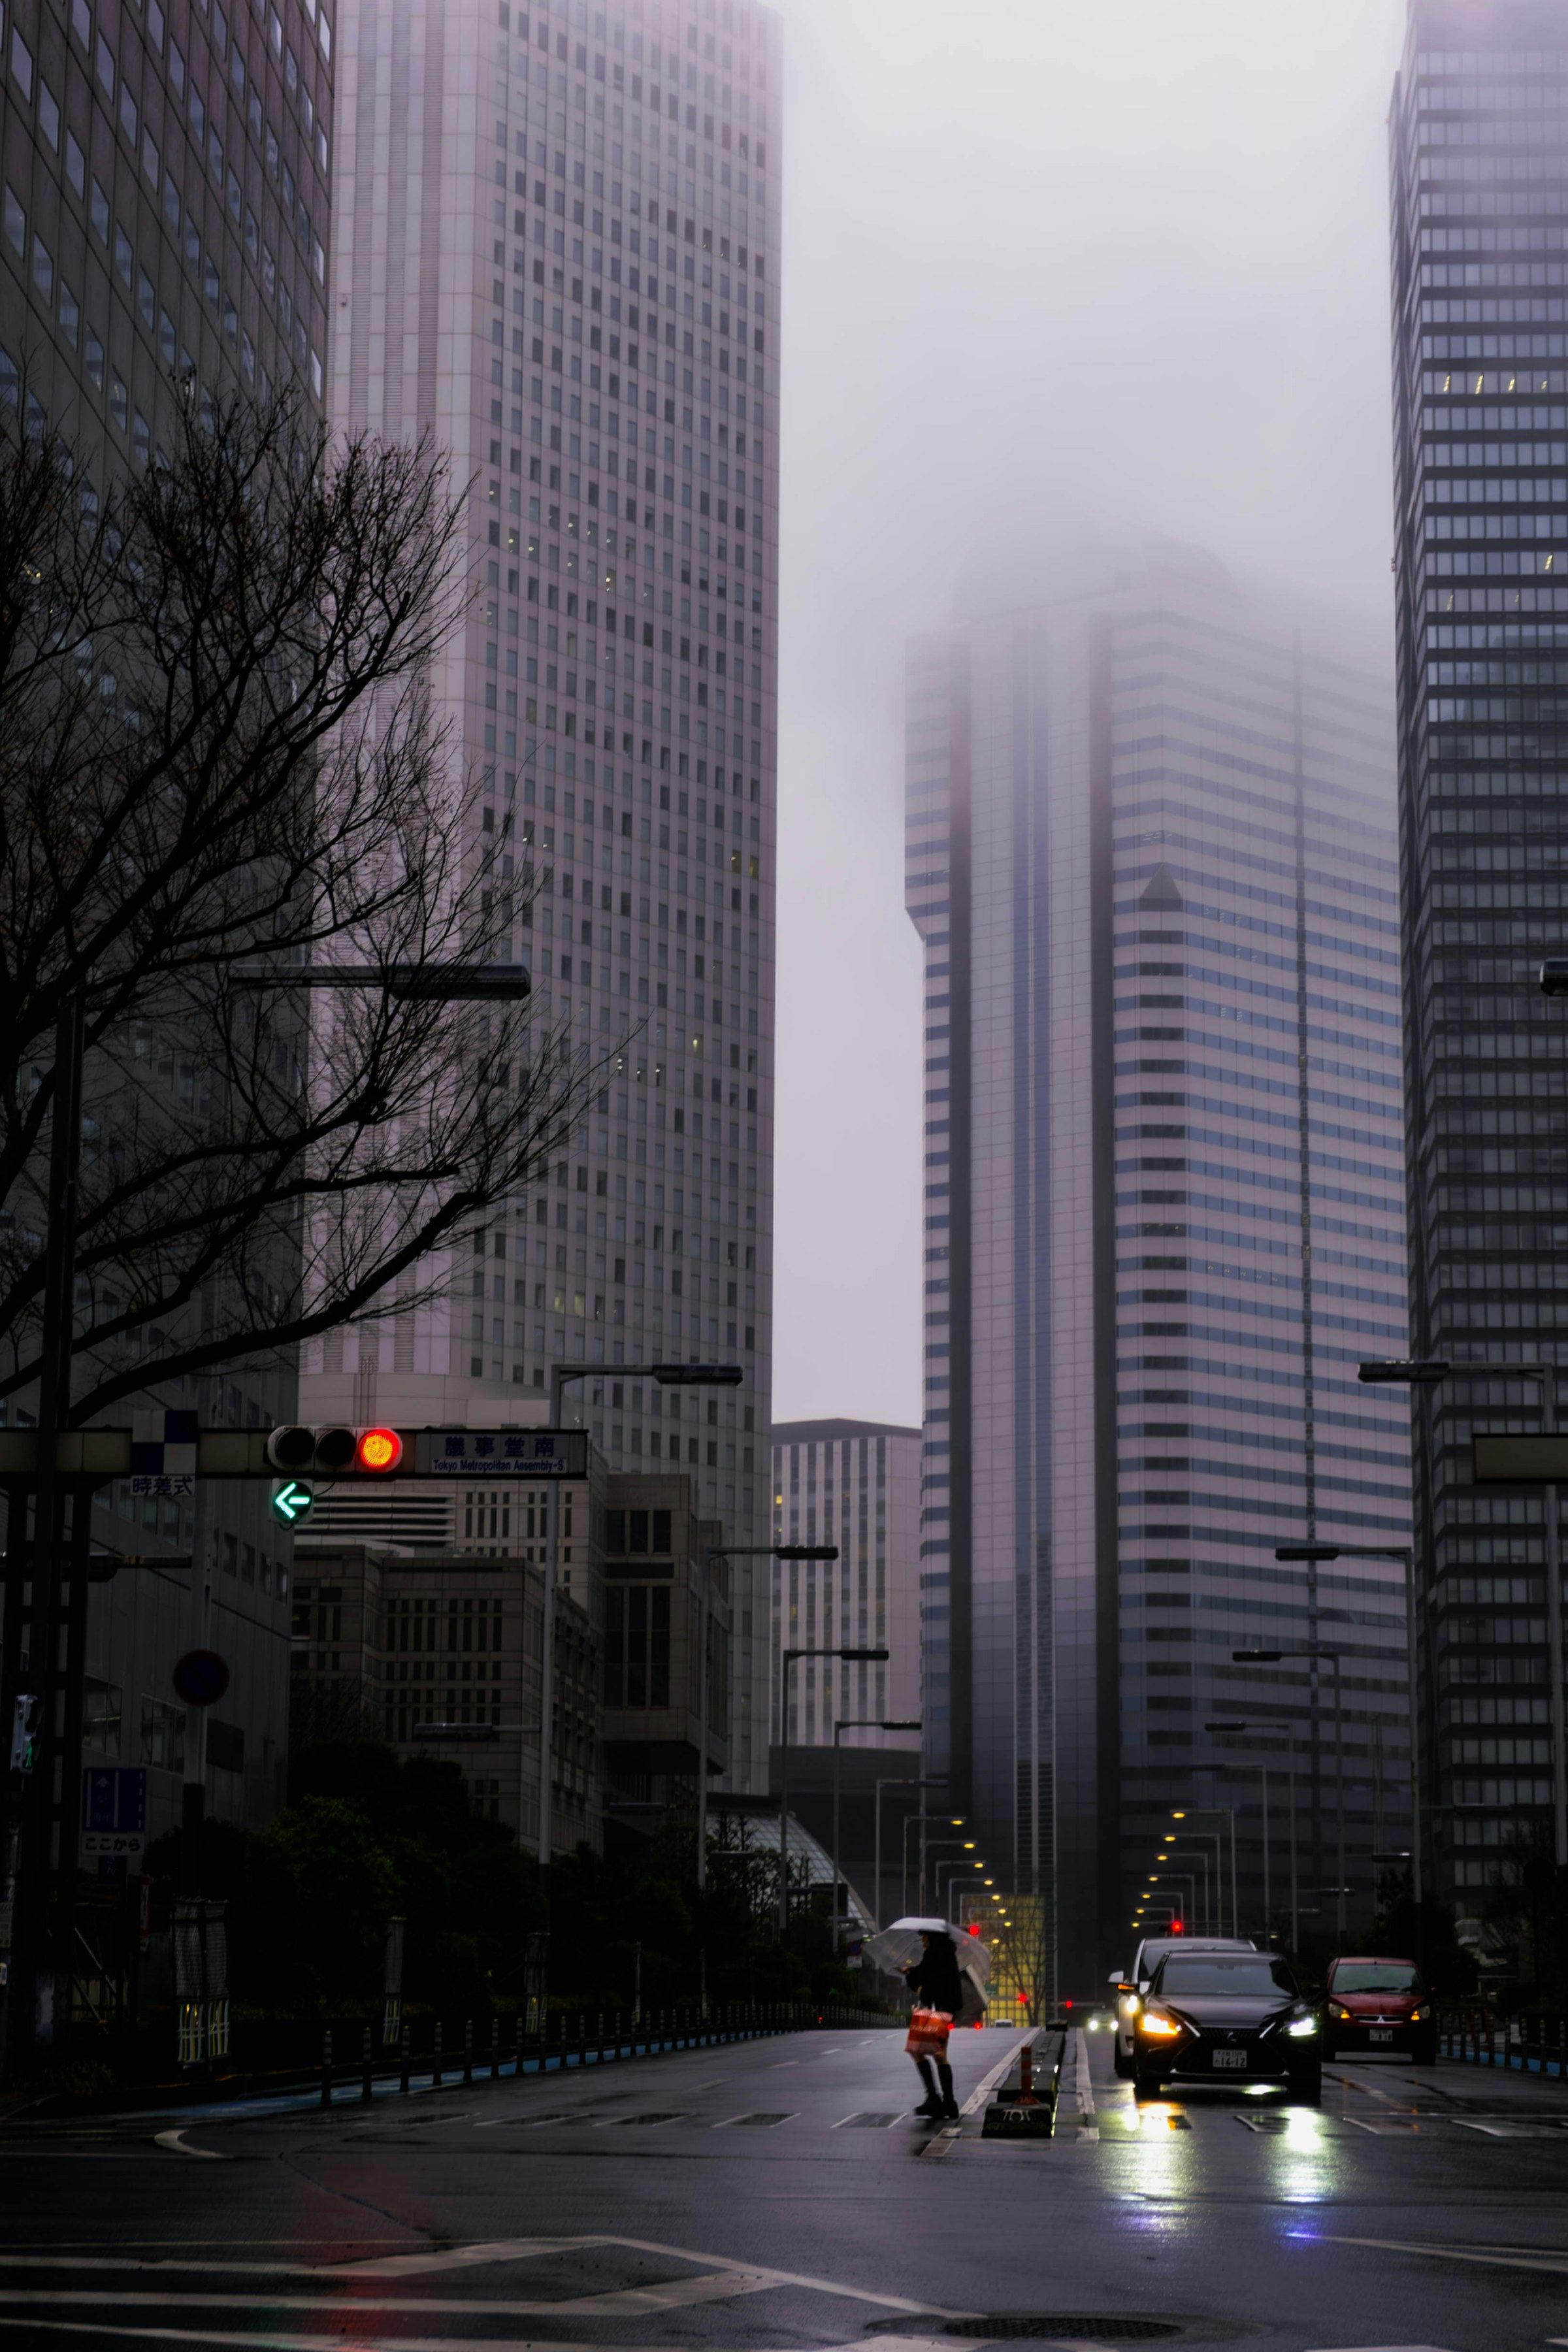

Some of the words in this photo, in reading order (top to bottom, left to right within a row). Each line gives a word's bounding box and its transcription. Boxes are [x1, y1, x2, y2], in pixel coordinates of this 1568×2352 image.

[445, 1437, 555, 1458] 議事堂南
[433, 1460, 457, 1473] Tokyo
[460, 1459, 510, 1473] Metropolitan
[133, 1477, 193, 1496] 時差式
[85, 1837, 140, 1852] ここから
